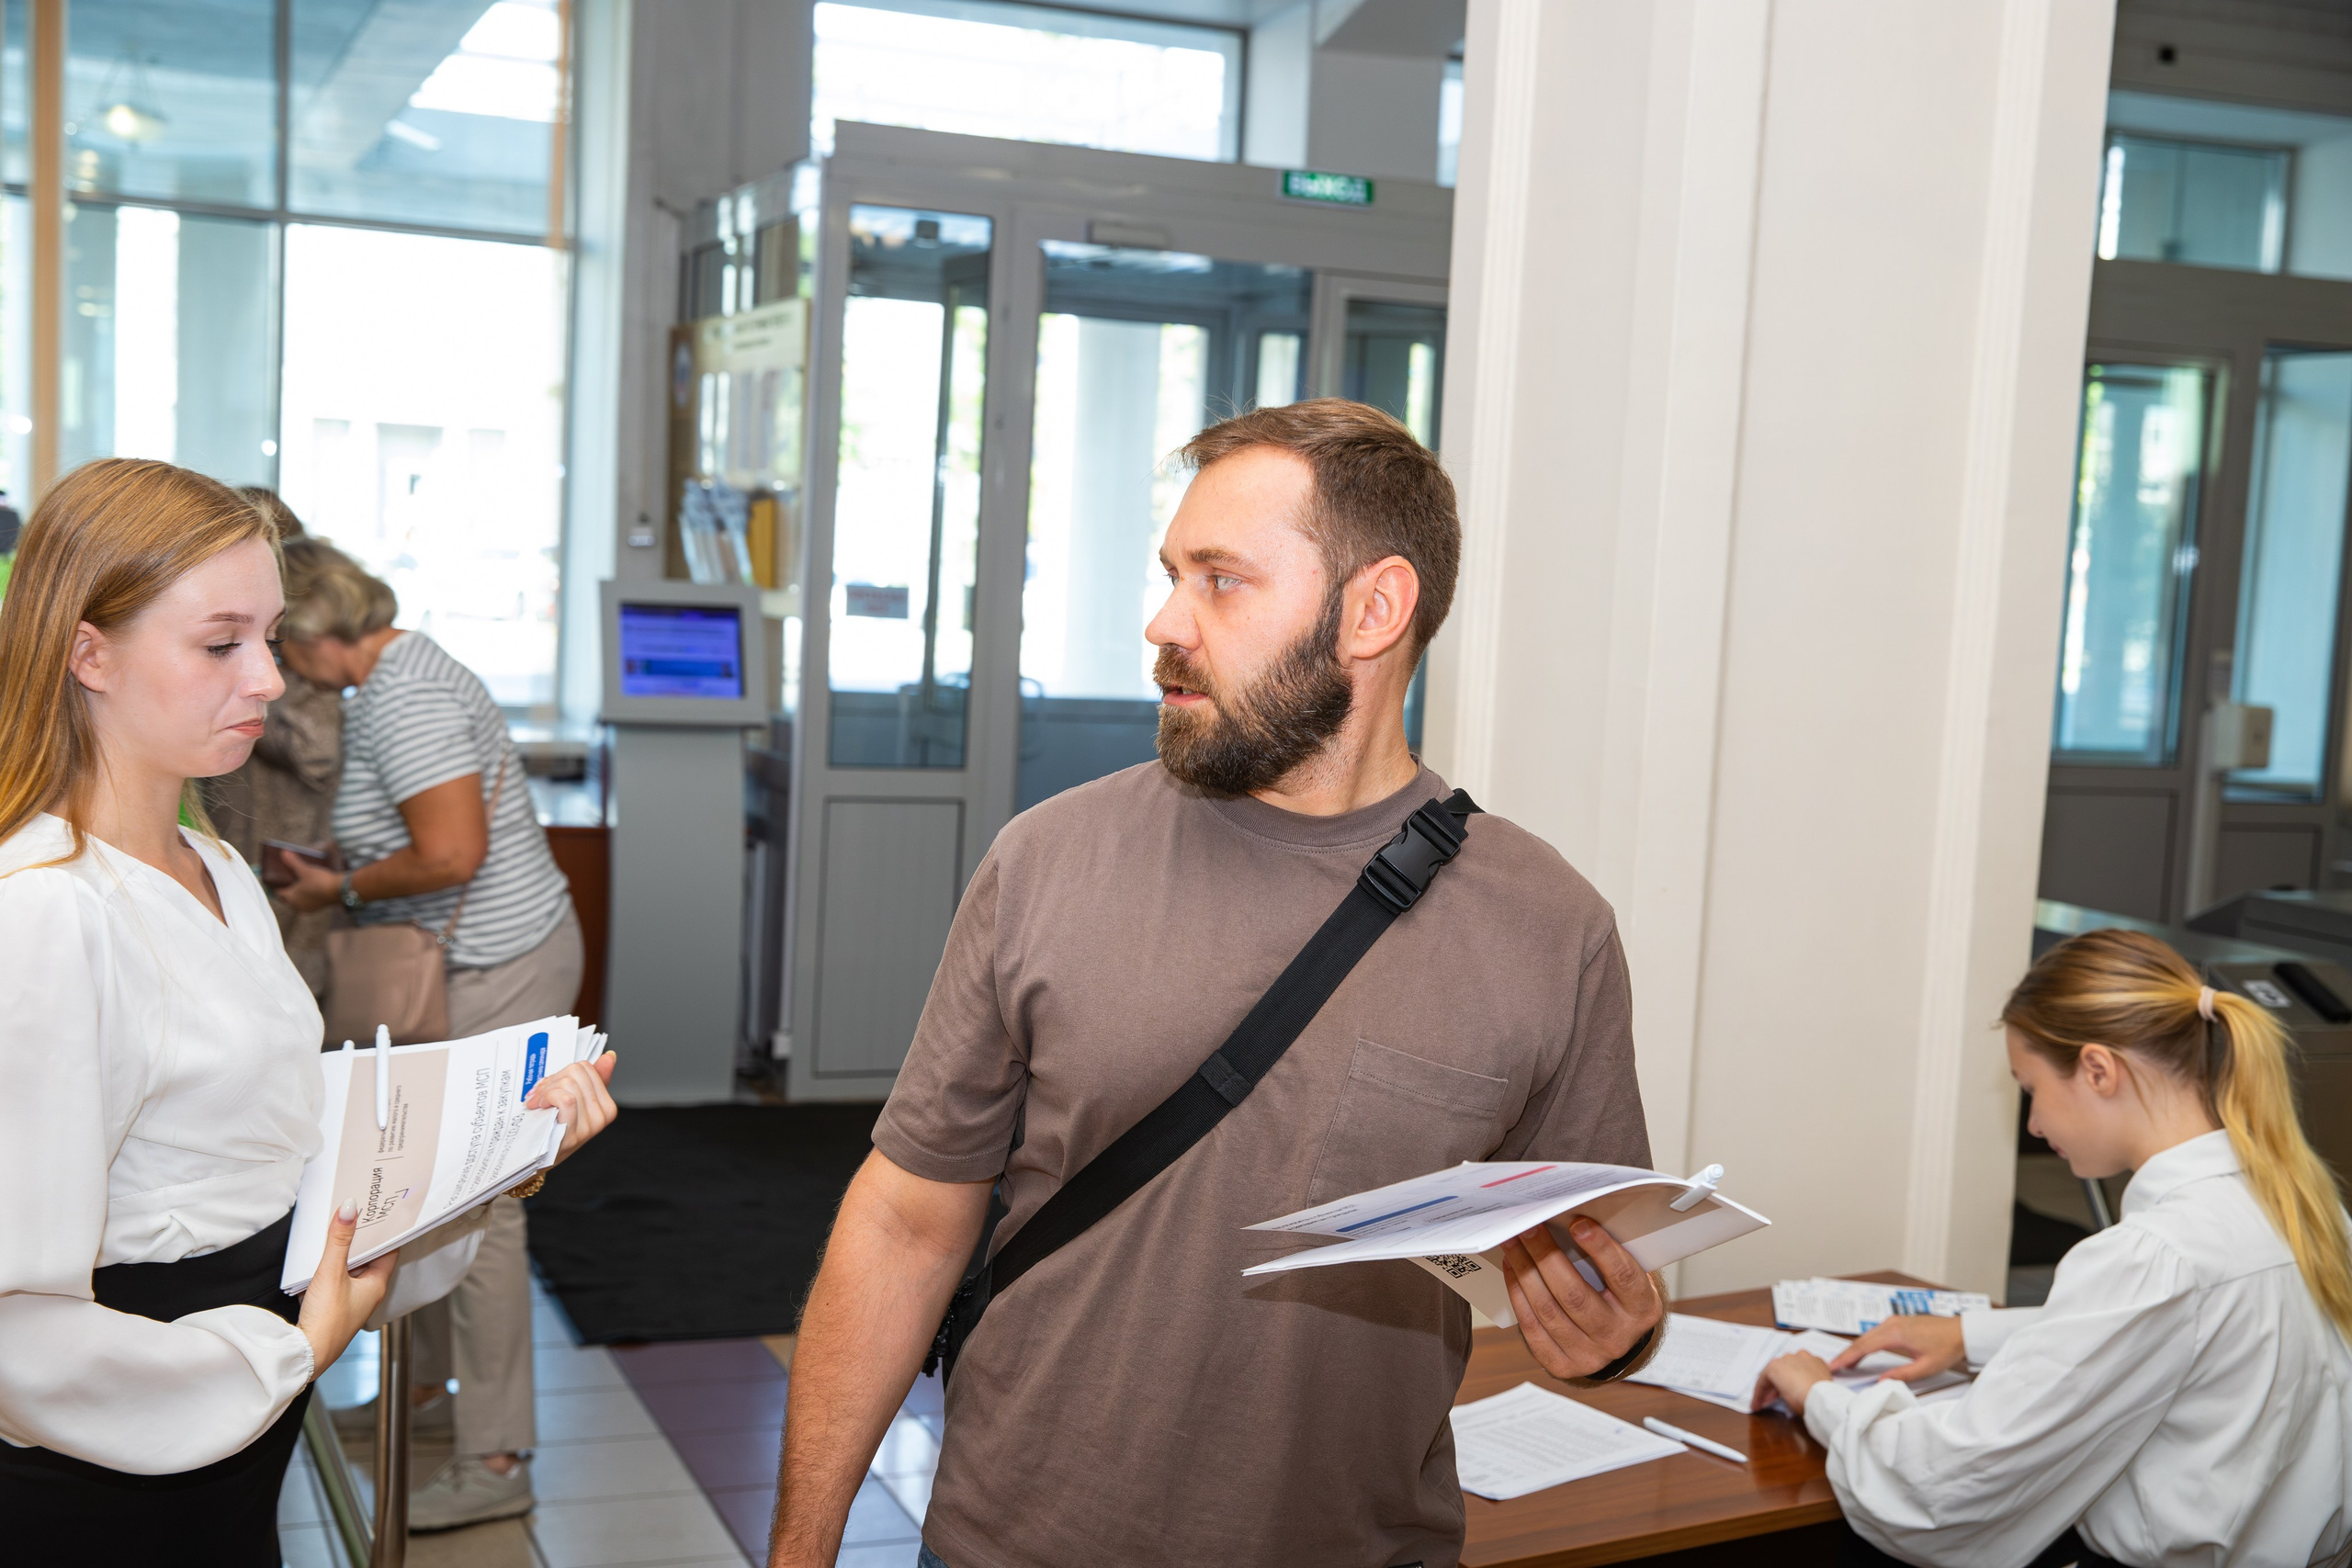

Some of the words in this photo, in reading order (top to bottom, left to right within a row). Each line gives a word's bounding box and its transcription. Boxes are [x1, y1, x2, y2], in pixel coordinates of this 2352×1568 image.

[475, 1067, 490, 1090] МСП
[498, 1069, 512, 1108] закупкам
[471, 1090, 488, 1134] субъектов
[362, 1167, 383, 1224] Корпорация
[377, 1195, 399, 1220] МСП
